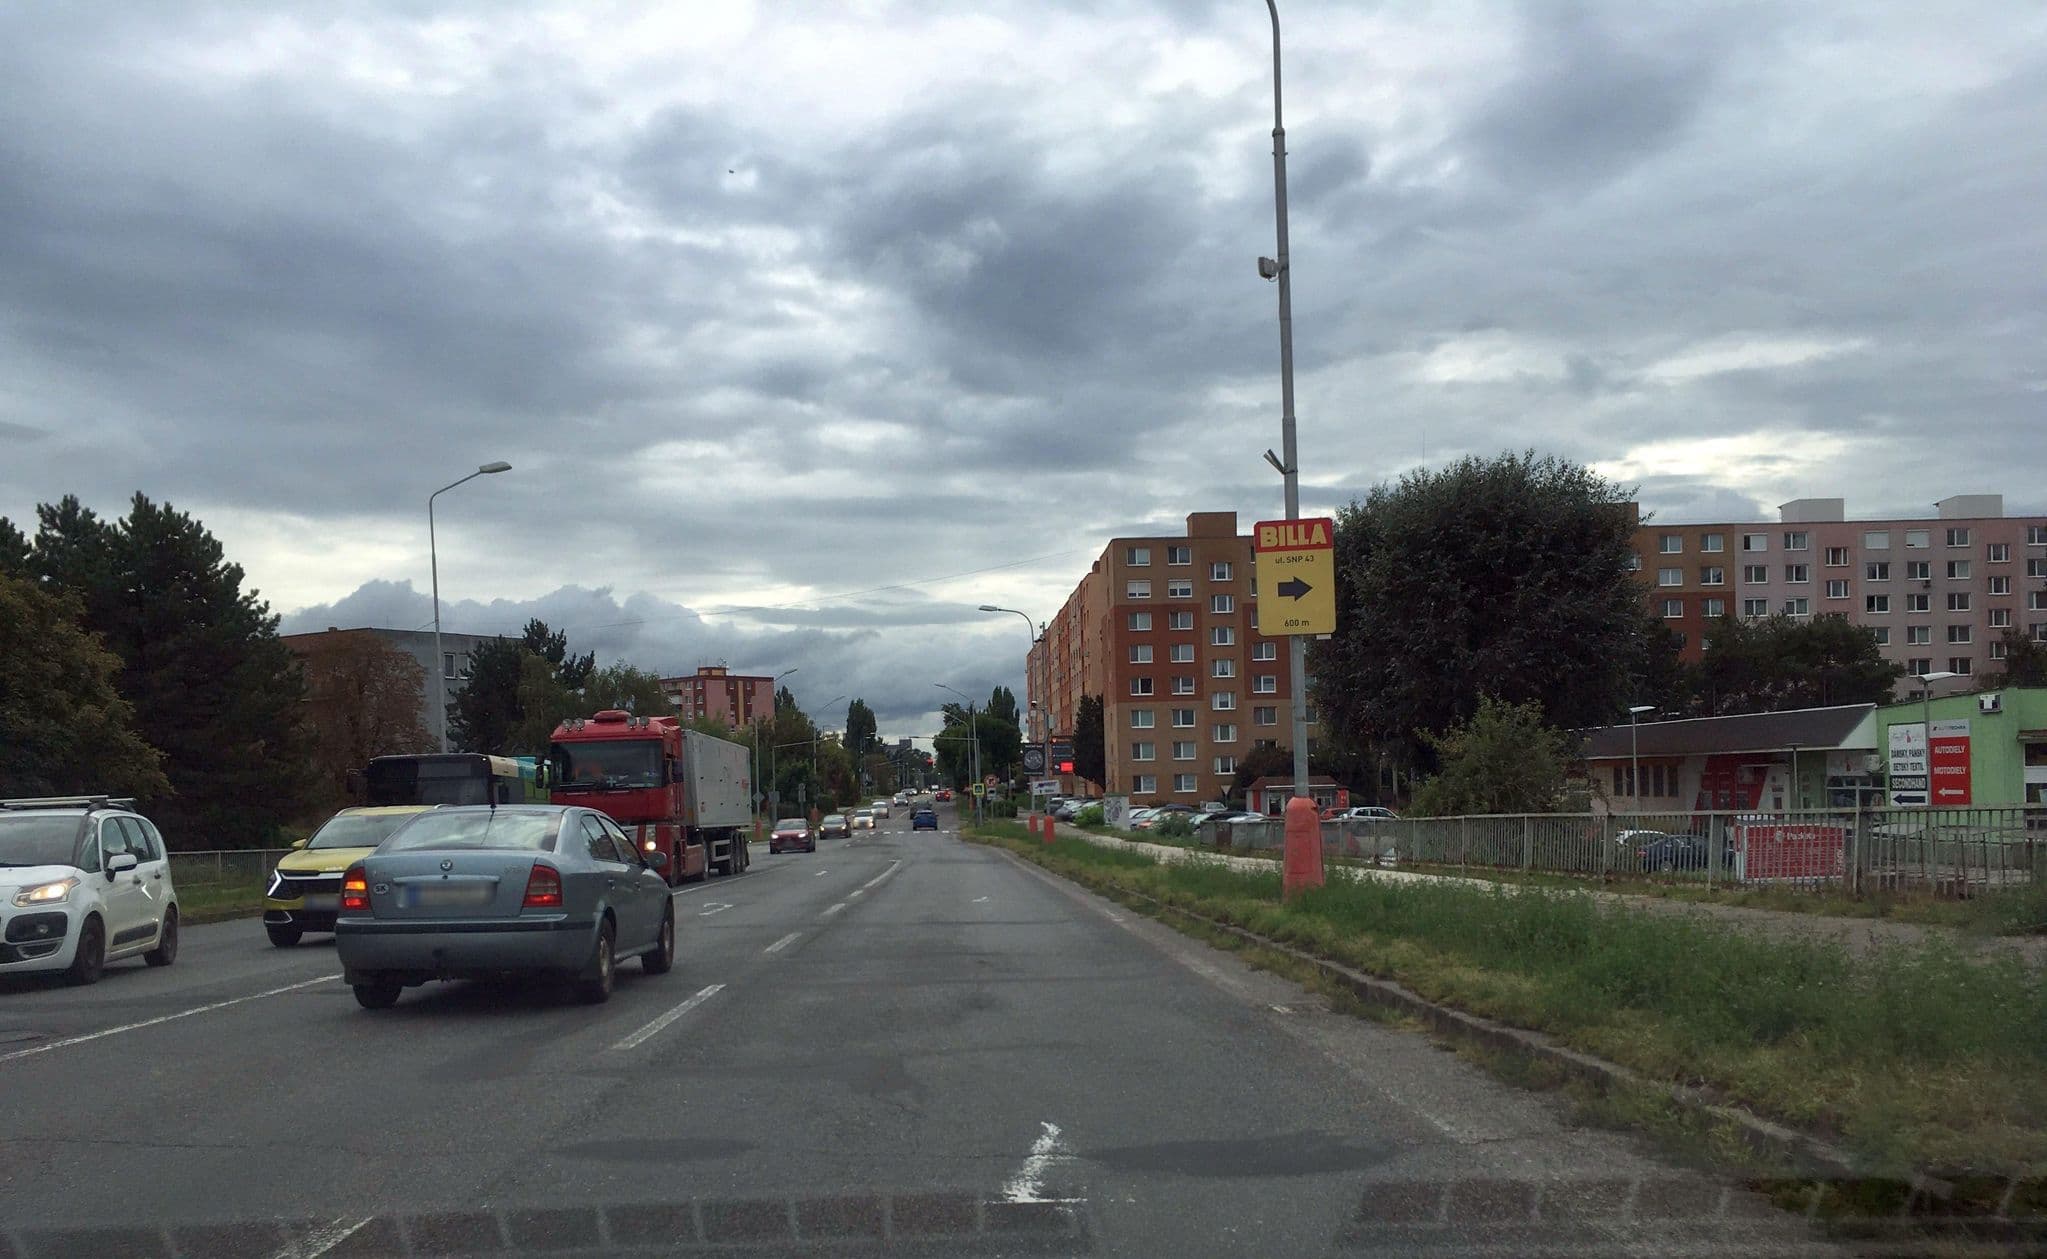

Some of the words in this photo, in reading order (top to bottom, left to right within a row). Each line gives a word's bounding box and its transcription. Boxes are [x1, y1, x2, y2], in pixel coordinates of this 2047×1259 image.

[1260, 524, 1327, 548] BILLA
[1286, 555, 1303, 563] SNP
[1284, 619, 1299, 627] 600
[1935, 745, 1966, 754] AUTODIELY
[1934, 766, 1967, 775] MOTODIELY
